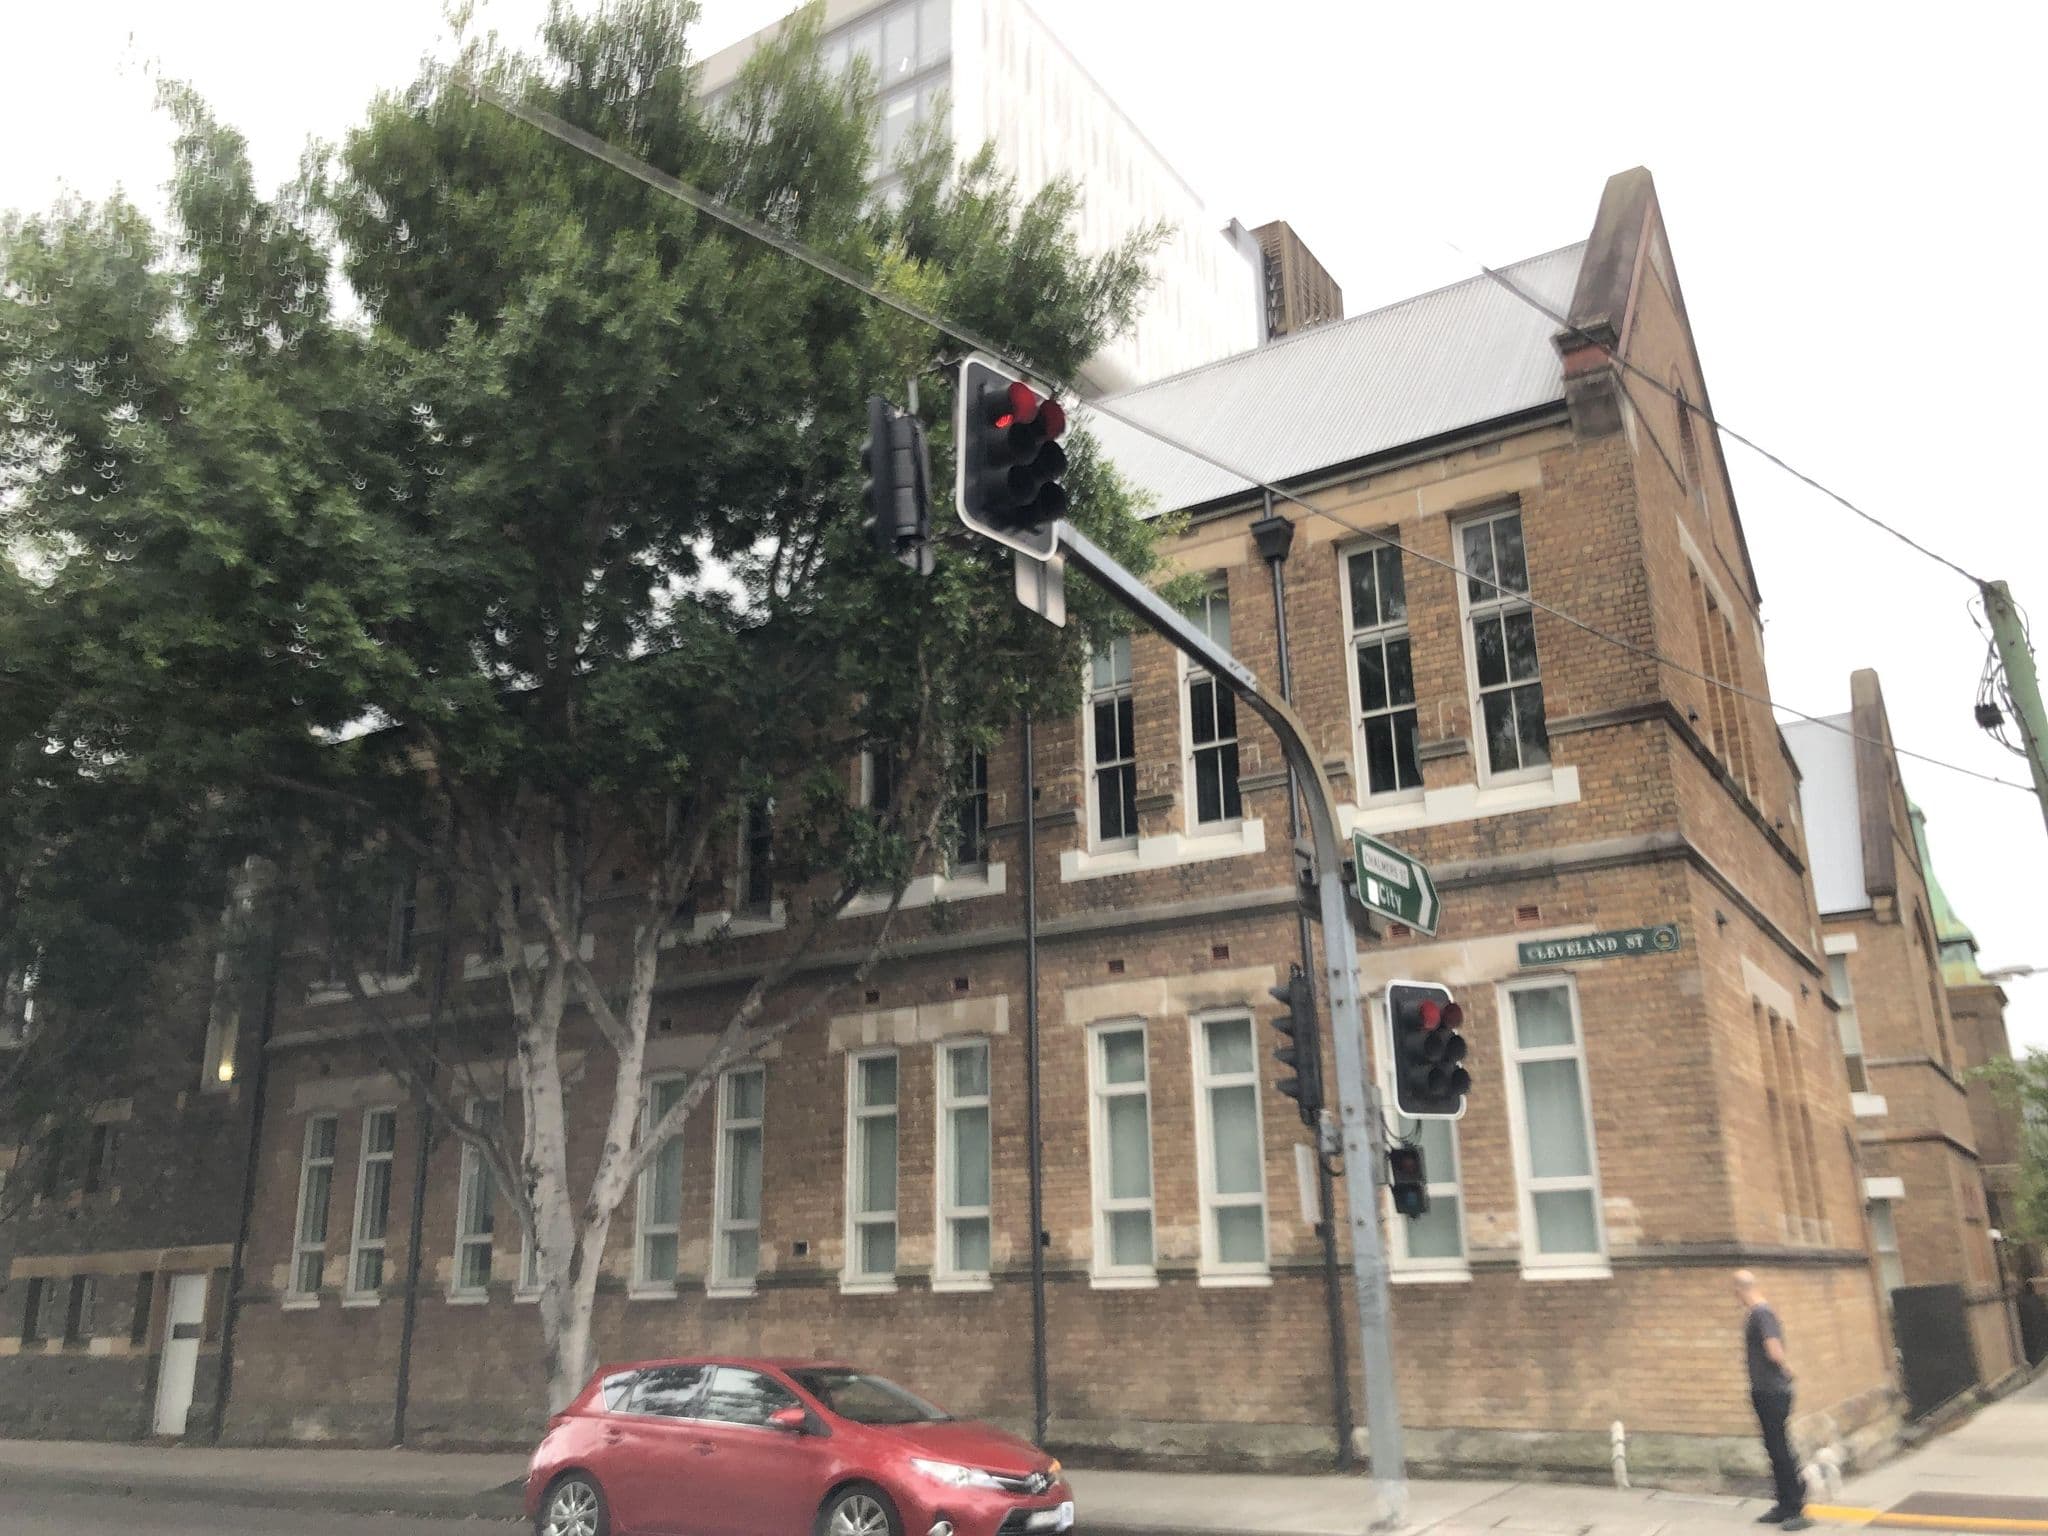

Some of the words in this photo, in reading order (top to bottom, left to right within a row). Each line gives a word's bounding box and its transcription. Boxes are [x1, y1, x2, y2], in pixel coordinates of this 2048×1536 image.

[1378, 881, 1402, 915] City
[1527, 937, 1618, 960] CLEVELAND
[1625, 933, 1645, 950] ST
